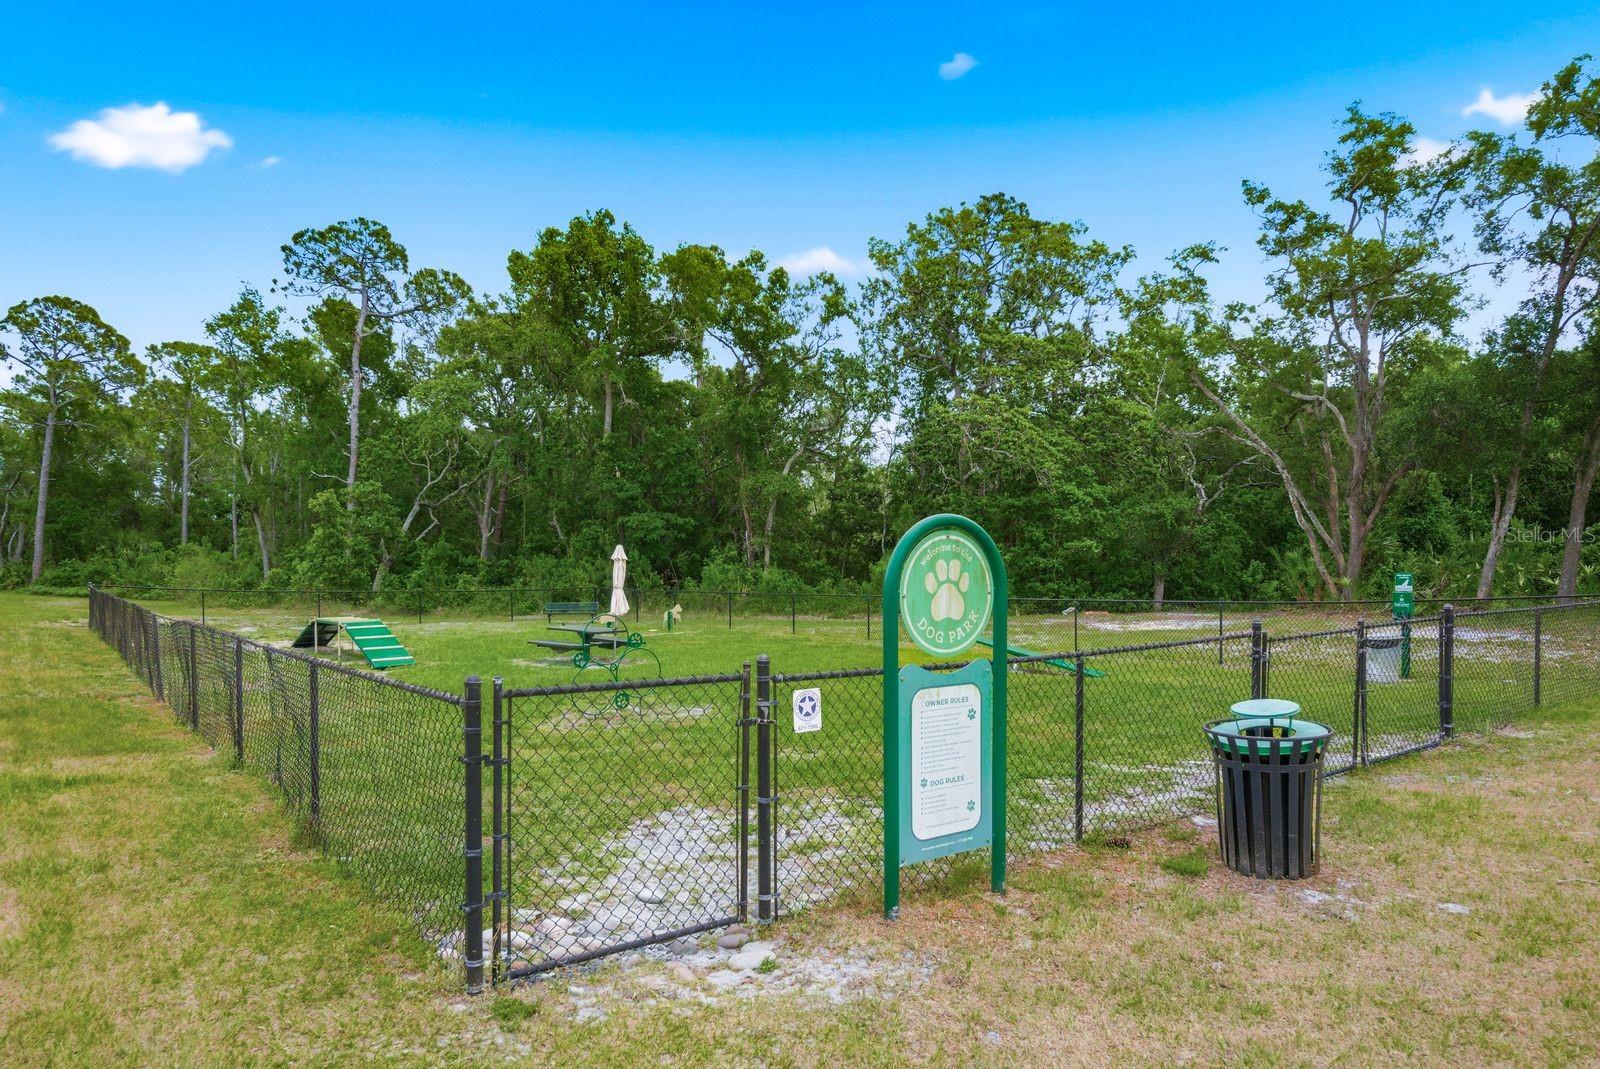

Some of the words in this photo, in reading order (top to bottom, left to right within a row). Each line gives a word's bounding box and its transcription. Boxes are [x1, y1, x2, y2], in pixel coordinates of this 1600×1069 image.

[920, 544, 952, 566] welcome
[952, 544, 961, 554] to
[961, 548, 973, 563] the
[917, 617, 944, 643] DOG
[948, 610, 979, 643] PARK
[925, 698, 949, 707] OWNER
[950, 696, 969, 705] RULES
[930, 779, 944, 787] DOG
[945, 775, 965, 784] RULES
